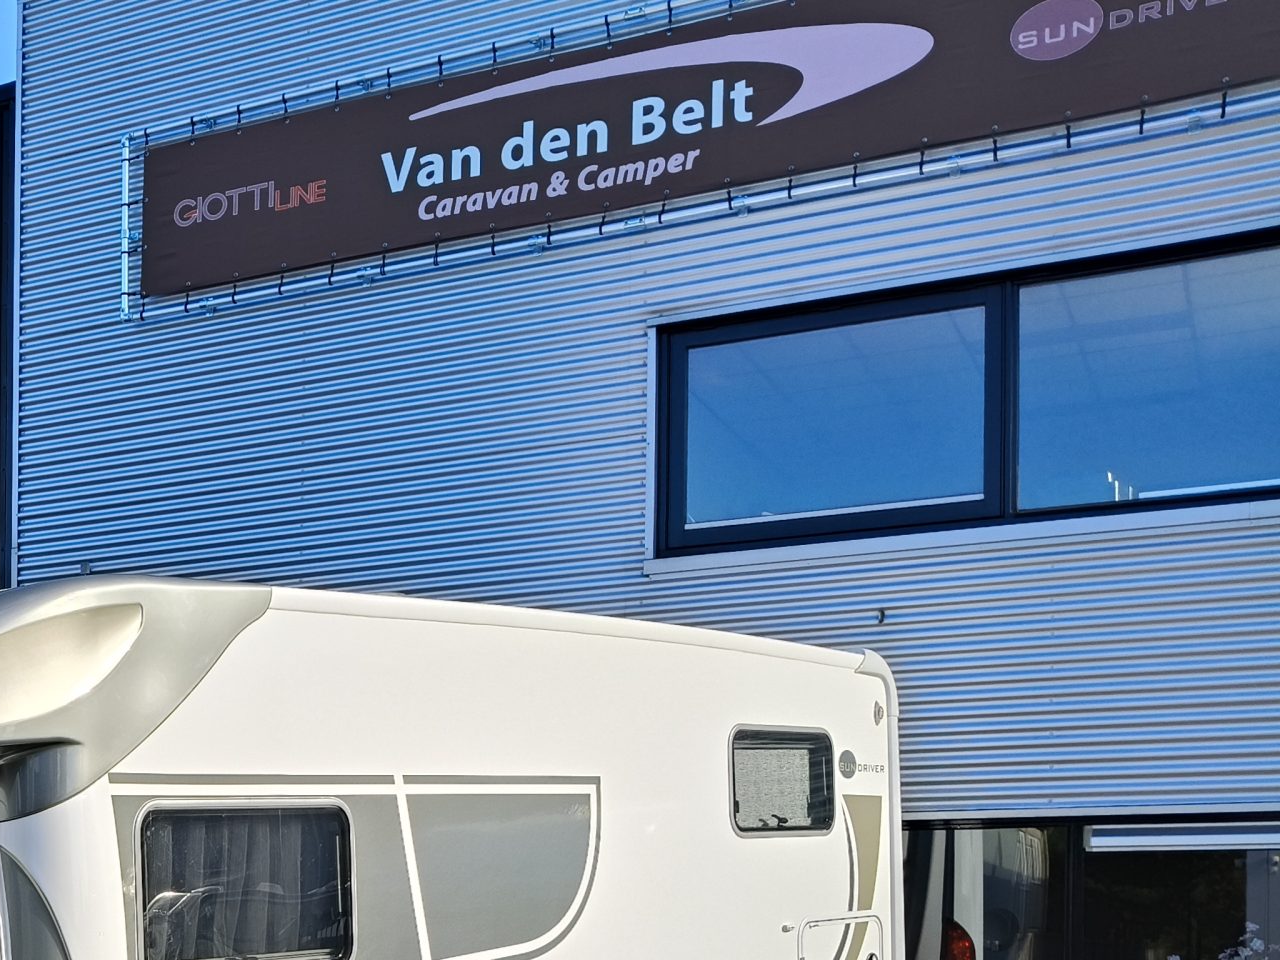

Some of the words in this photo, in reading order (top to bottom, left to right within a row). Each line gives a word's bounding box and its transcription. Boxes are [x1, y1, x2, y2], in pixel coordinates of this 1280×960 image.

[1018, 17, 1095, 49] SUN
[380, 144, 482, 194] Van
[500, 119, 609, 171] den
[631, 79, 754, 146] Belt
[417, 179, 539, 221] Caravan
[546, 170, 570, 199] &
[577, 148, 701, 192] Camper
[839, 761, 856, 772] SUN
[857, 763, 885, 774] DRIVER
